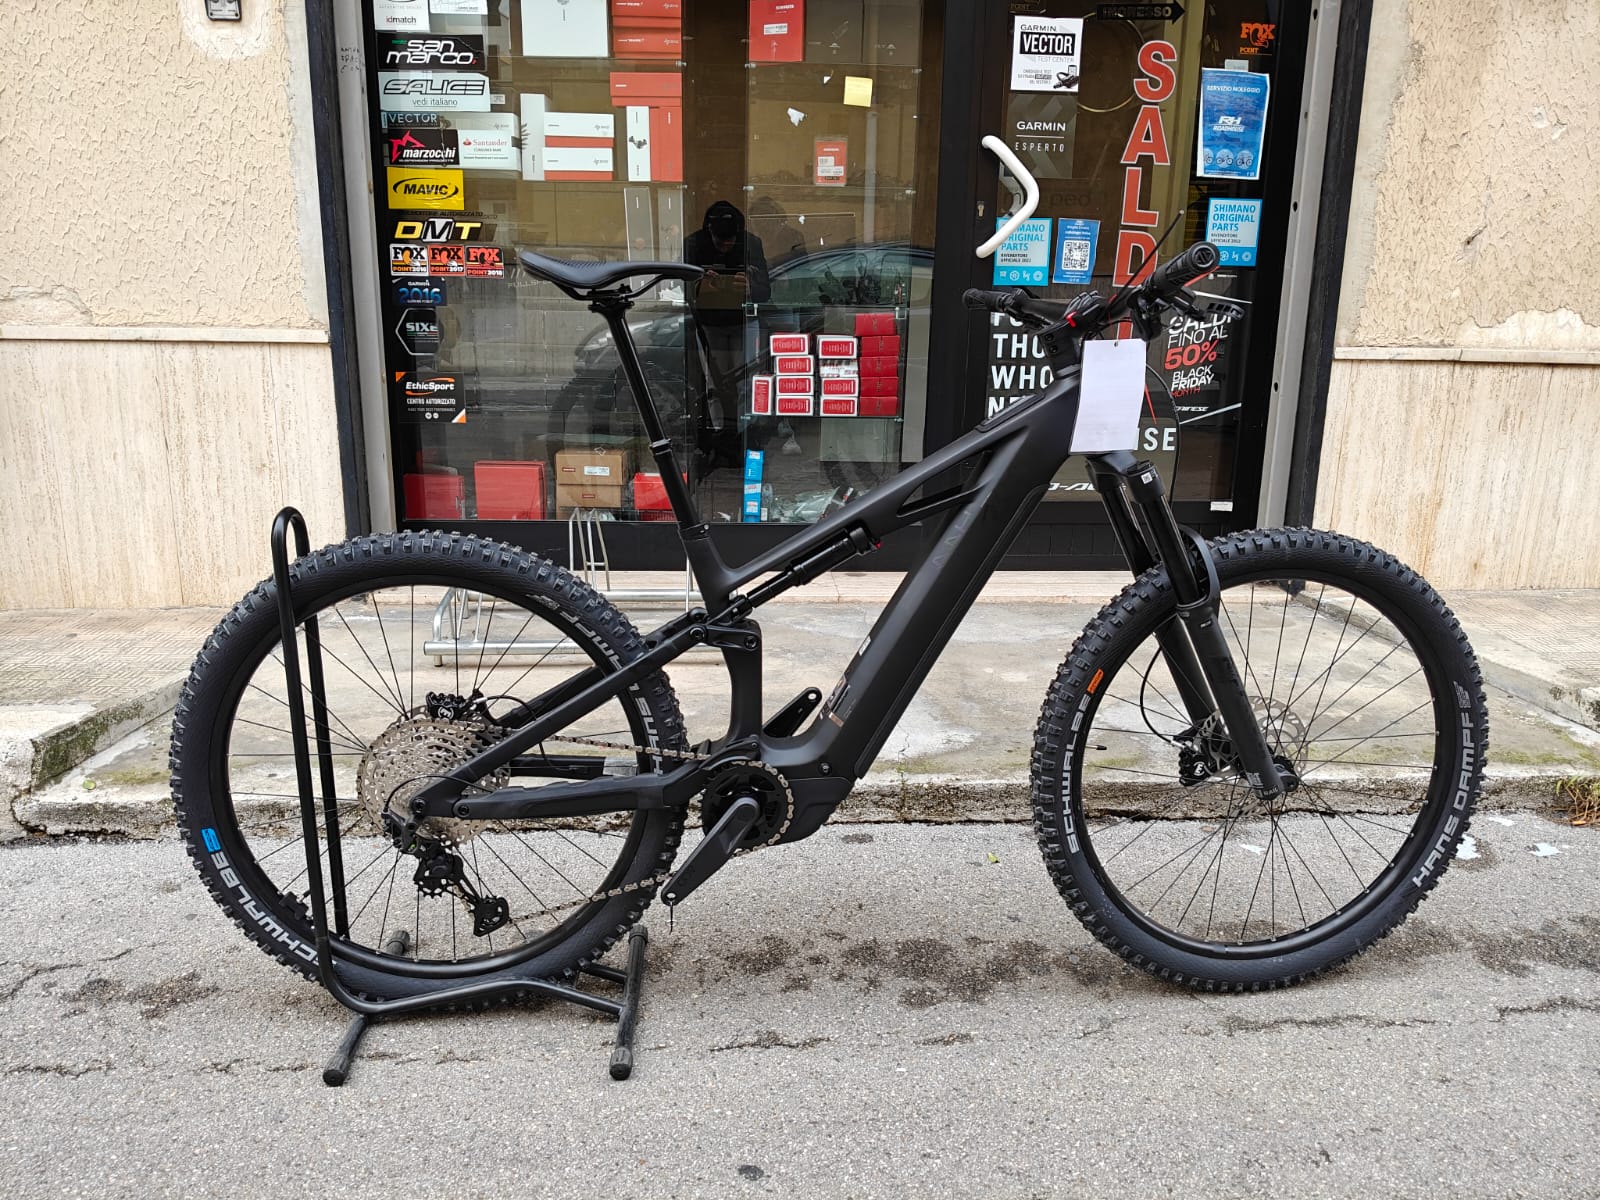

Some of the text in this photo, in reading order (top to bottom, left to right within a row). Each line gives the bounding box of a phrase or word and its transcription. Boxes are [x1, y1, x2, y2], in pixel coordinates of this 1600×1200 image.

[386, 16, 417, 24] idmatch
[1020, 24, 1057, 32] GARMIN
[1240, 23, 1275, 48] FOX
[407, 40, 455, 53] san
[1023, 34, 1073, 54] VECTOR
[386, 51, 474, 64] marco
[383, 79, 486, 96] SALICE
[430, 97, 458, 106] italiano
[388, 113, 438, 124] VECTOR
[1016, 120, 1067, 132] GARMIN
[472, 138, 508, 146] Santander
[1015, 142, 1065, 153] ESPERTO
[402, 147, 457, 159] marzocchi
[403, 183, 449, 195] MAVIC
[1213, 203, 1256, 213] SHIMANO
[1212, 213, 1256, 223] ORIGINAL
[394, 217, 482, 243] DMT
[1005, 223, 1046, 232] MANO
[1211, 222, 1239, 232] PARTS
[1006, 233, 1045, 242] RIGINAL
[1001, 242, 1029, 251] PARTS
[392, 246, 426, 261] FOX
[430, 246, 463, 262] FOX
[467, 246, 500, 263] FOX
[398, 287, 443, 304] 2016
[1167, 325, 1229, 349] FINO AL
[992, 333, 1046, 359] THO
[1164, 339, 1219, 371] 50%
[1172, 364, 1213, 381] BLACK
[405, 382, 455, 392] EthicSport
[1170, 374, 1215, 392] FRIDAY
[1171, 386, 1201, 398] MONTH
[1062, 693, 1092, 854] SCHWALBE
[1412, 711, 1475, 888] HANS DAMPF
